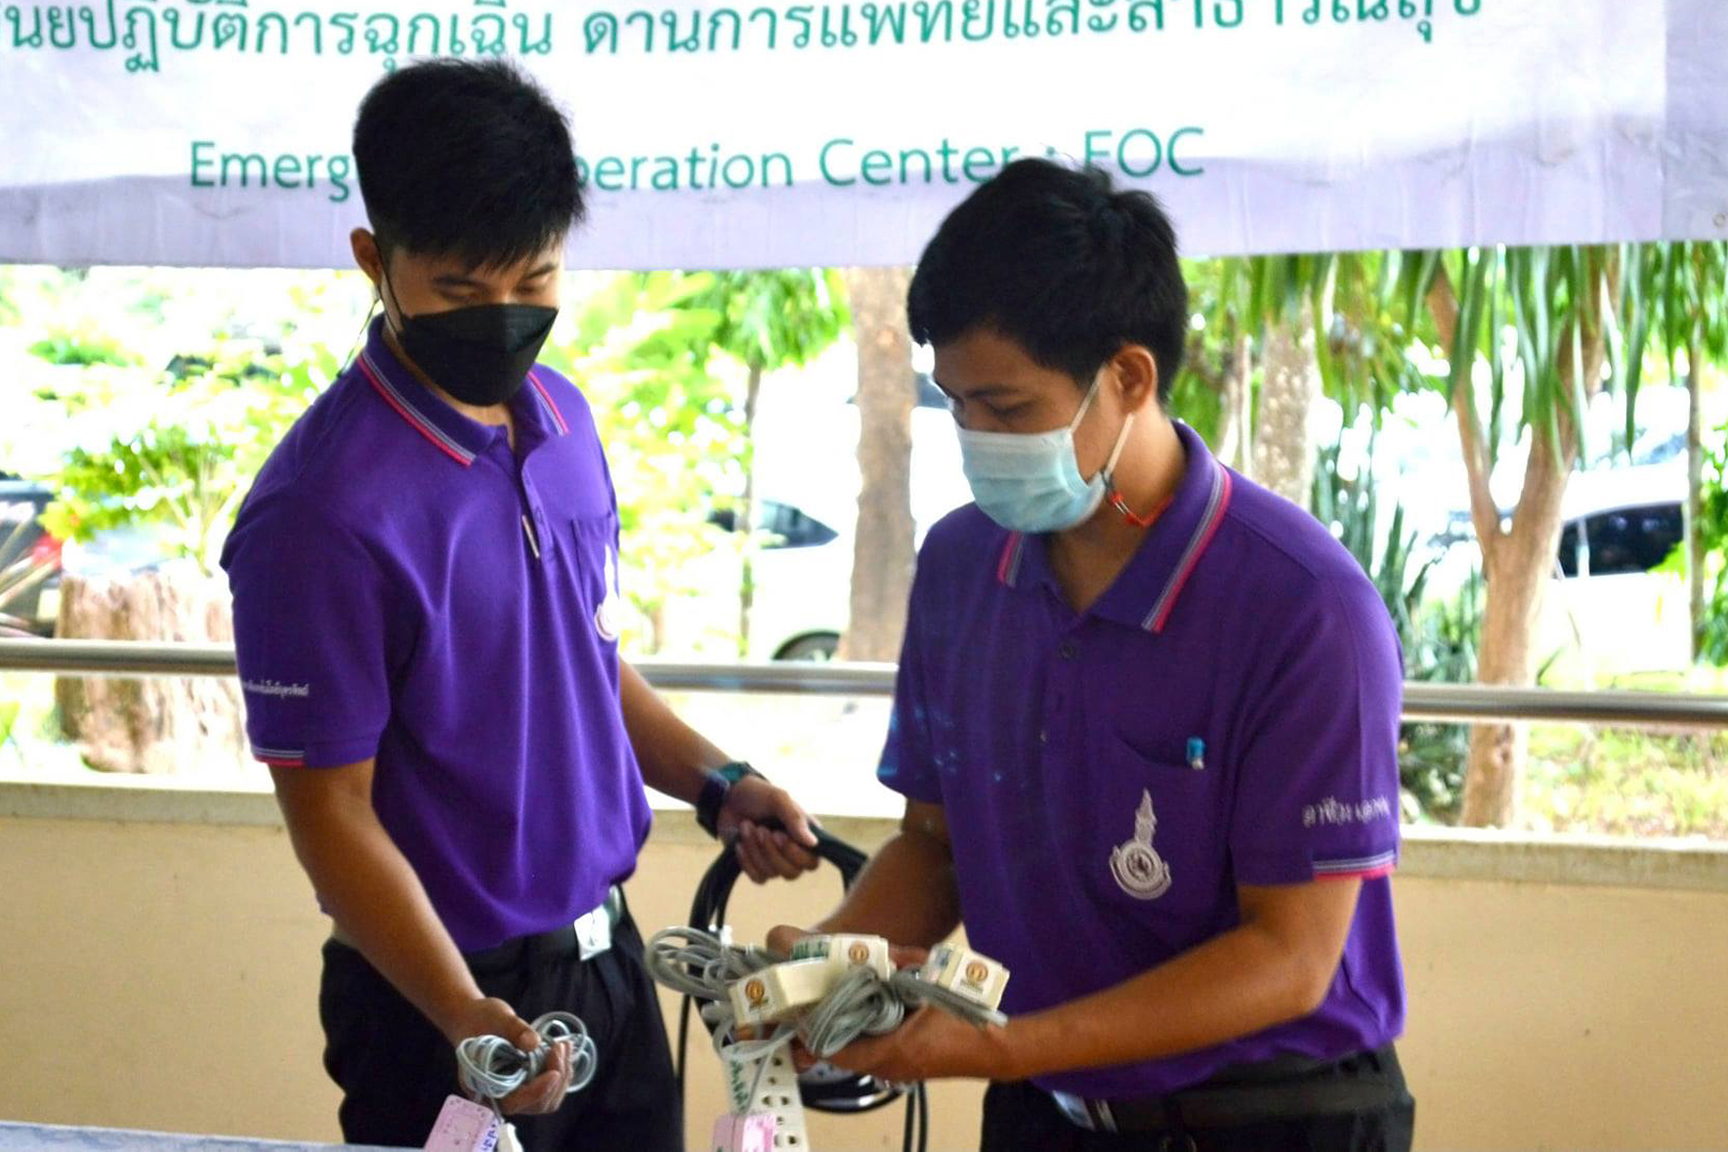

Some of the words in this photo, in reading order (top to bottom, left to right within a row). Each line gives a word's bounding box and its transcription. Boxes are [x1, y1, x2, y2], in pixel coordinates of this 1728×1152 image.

[190, 139, 350, 203] Emerg
[575, 142, 795, 193] eration
[818, 137, 1020, 188] Center
